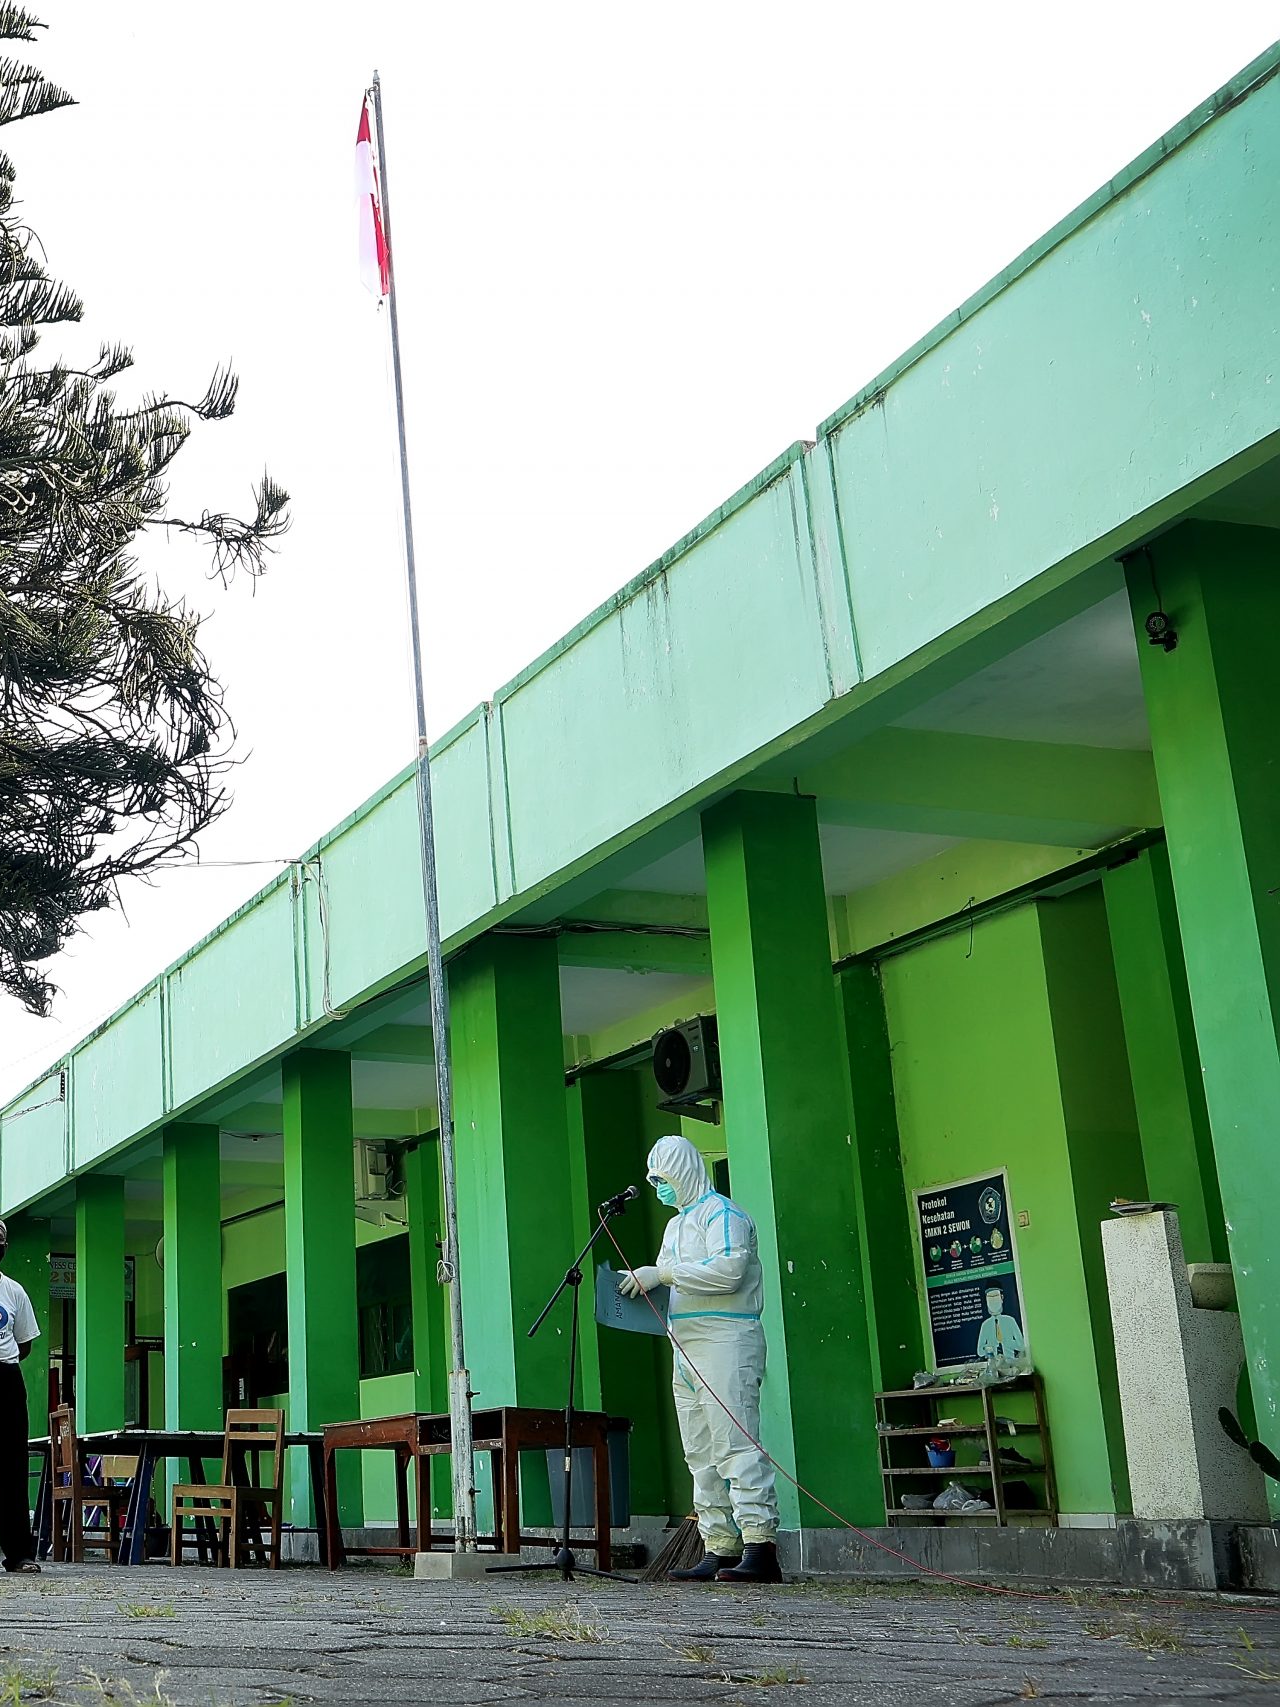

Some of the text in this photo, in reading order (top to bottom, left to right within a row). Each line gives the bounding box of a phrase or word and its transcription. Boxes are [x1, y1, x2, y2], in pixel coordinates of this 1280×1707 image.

[921, 1196, 947, 1211] Protokol
[922, 1210, 955, 1224] Kesehatan
[943, 1226, 948, 1235] 2
[948, 1220, 971, 1234] SEWON
